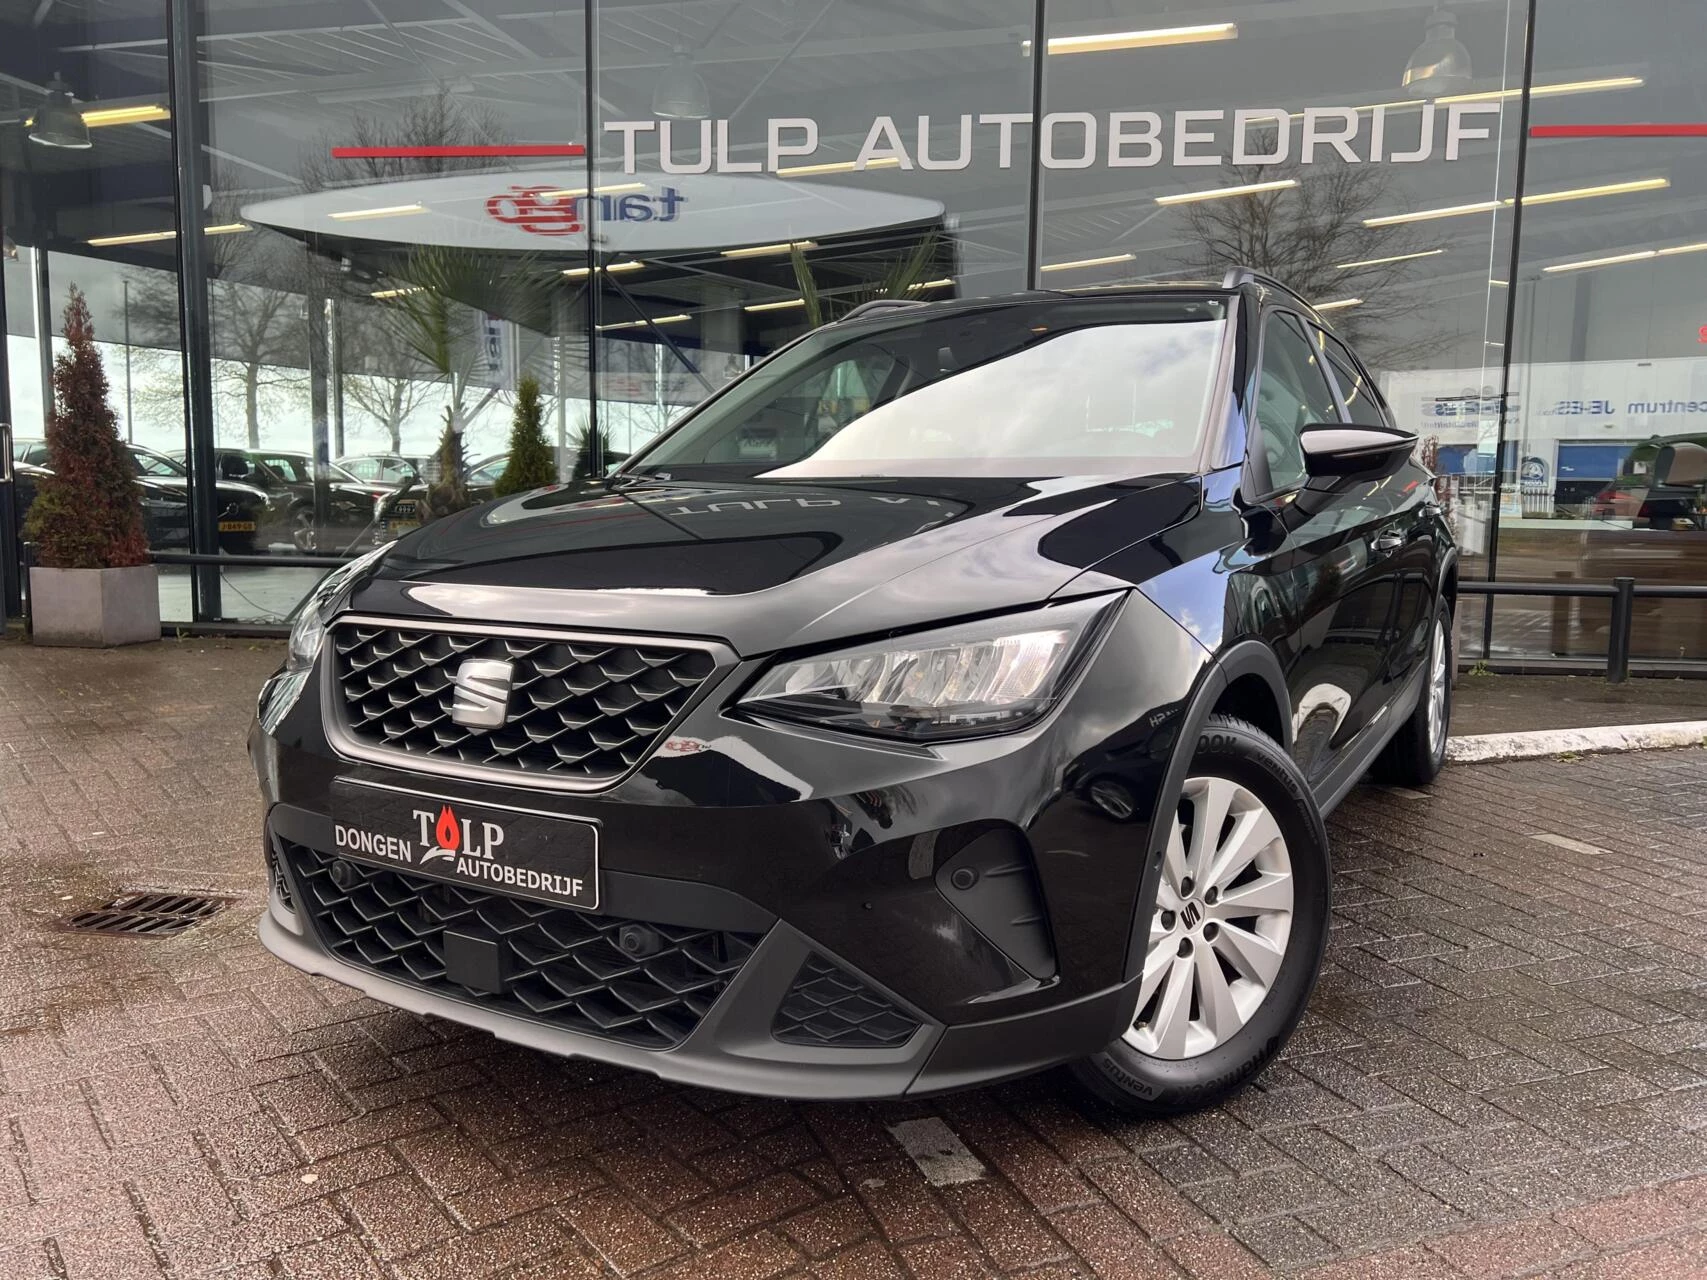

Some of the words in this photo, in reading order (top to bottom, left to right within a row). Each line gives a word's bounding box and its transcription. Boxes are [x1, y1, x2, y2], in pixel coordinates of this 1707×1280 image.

[604, 118, 817, 174] TULP
[854, 102, 1501, 171] AUTOBEDRIJF
[334, 825, 412, 862] DONGEN
[456, 857, 583, 897] AUTOBEDRIJF
